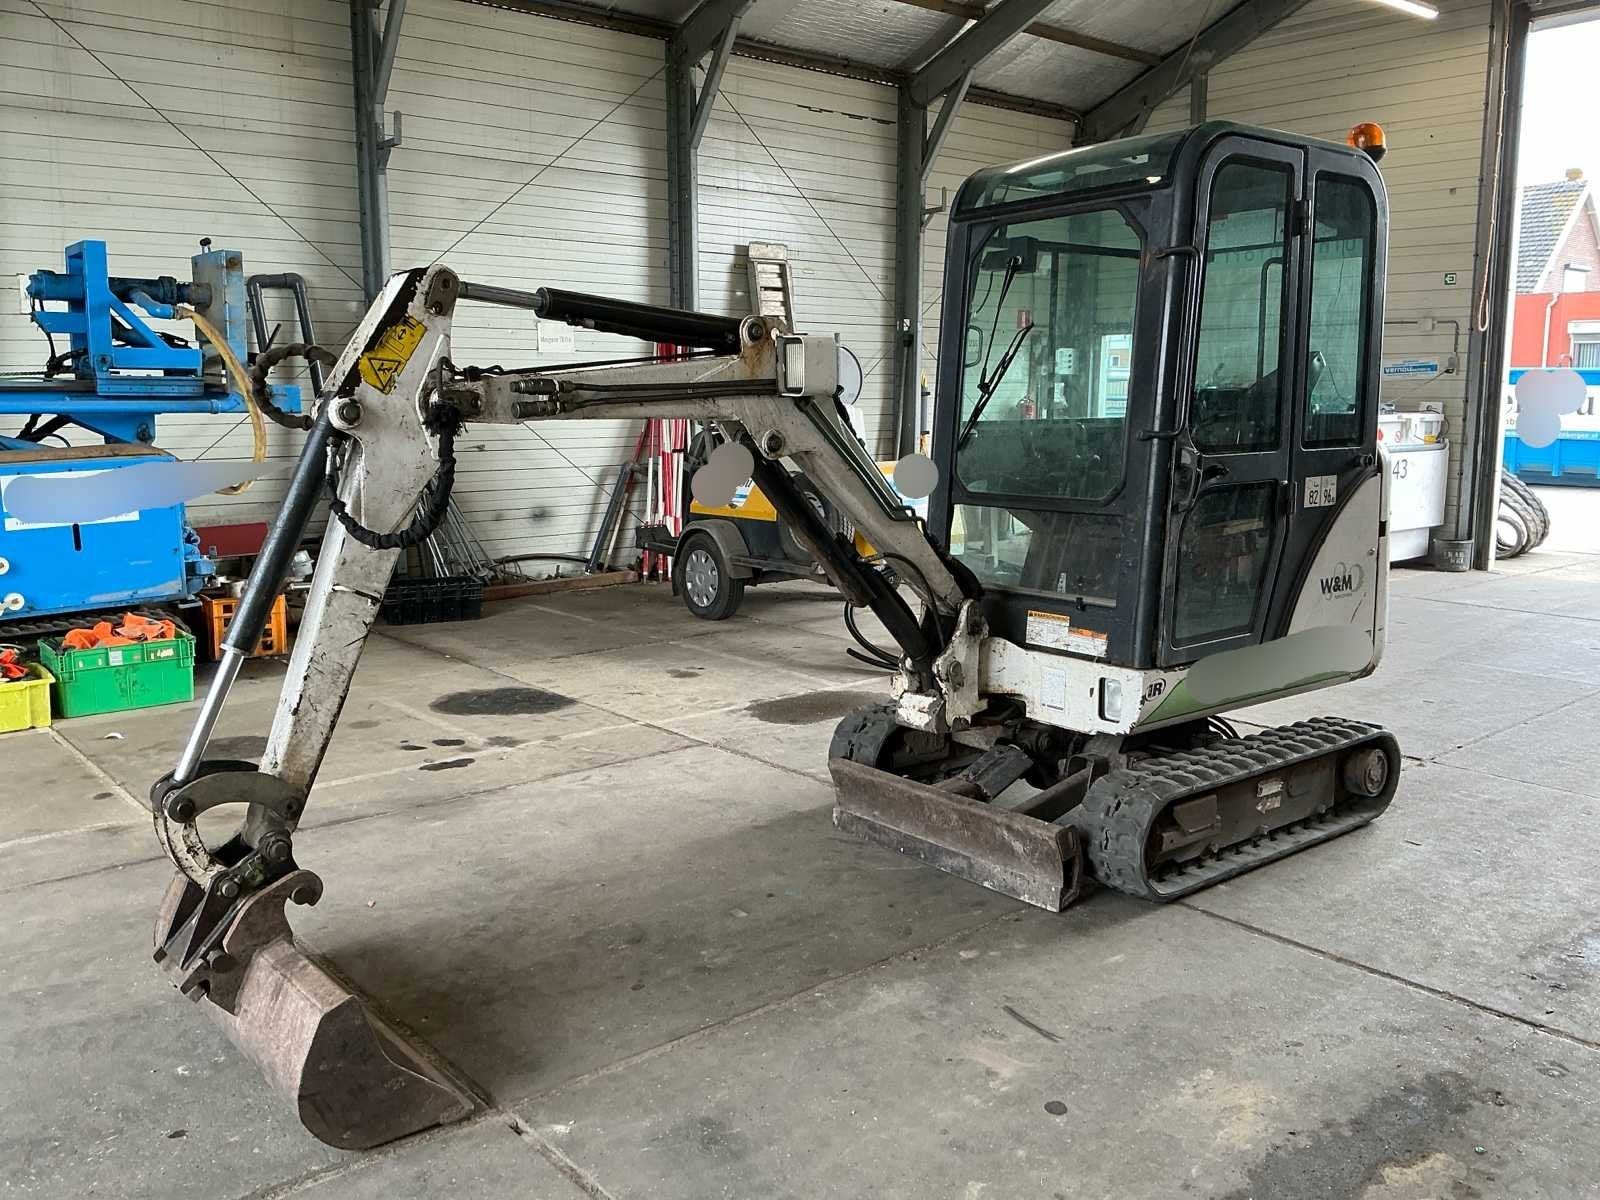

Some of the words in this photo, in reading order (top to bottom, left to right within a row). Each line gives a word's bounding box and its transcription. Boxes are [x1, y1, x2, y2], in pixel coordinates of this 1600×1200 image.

[1392, 459, 1408, 480] 43
[1309, 490, 1319, 505] 82
[1320, 574, 1353, 595] W&M
